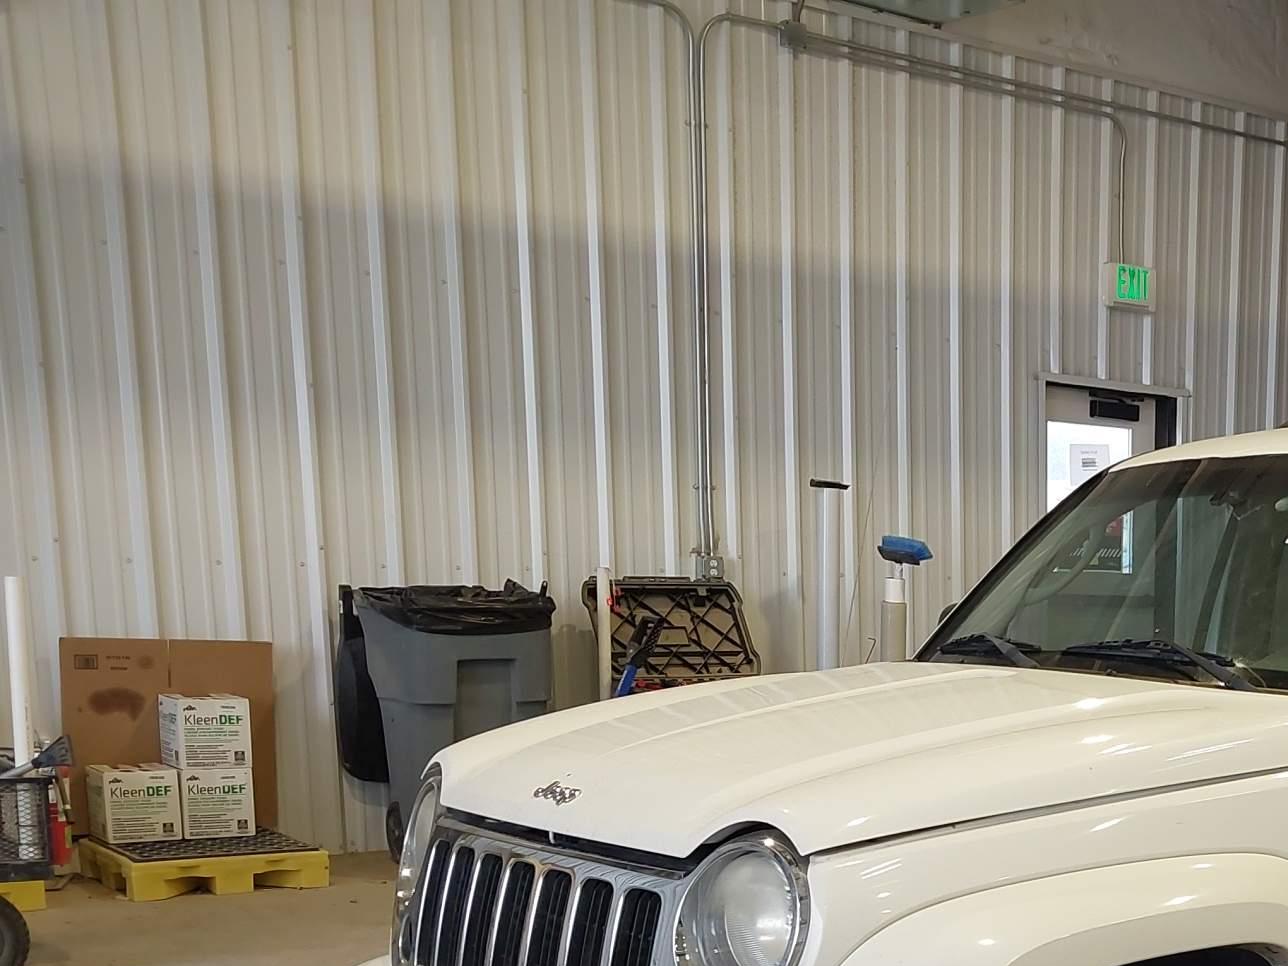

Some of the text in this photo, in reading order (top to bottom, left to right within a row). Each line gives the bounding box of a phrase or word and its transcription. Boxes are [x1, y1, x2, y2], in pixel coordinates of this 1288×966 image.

[1118, 265, 1148, 301] EXIT
[184, 714, 243, 726] KleenDEF
[110, 785, 172, 799] KleenDEF
[187, 783, 248, 796] KleenDEF
[533, 780, 581, 806] Jeep
